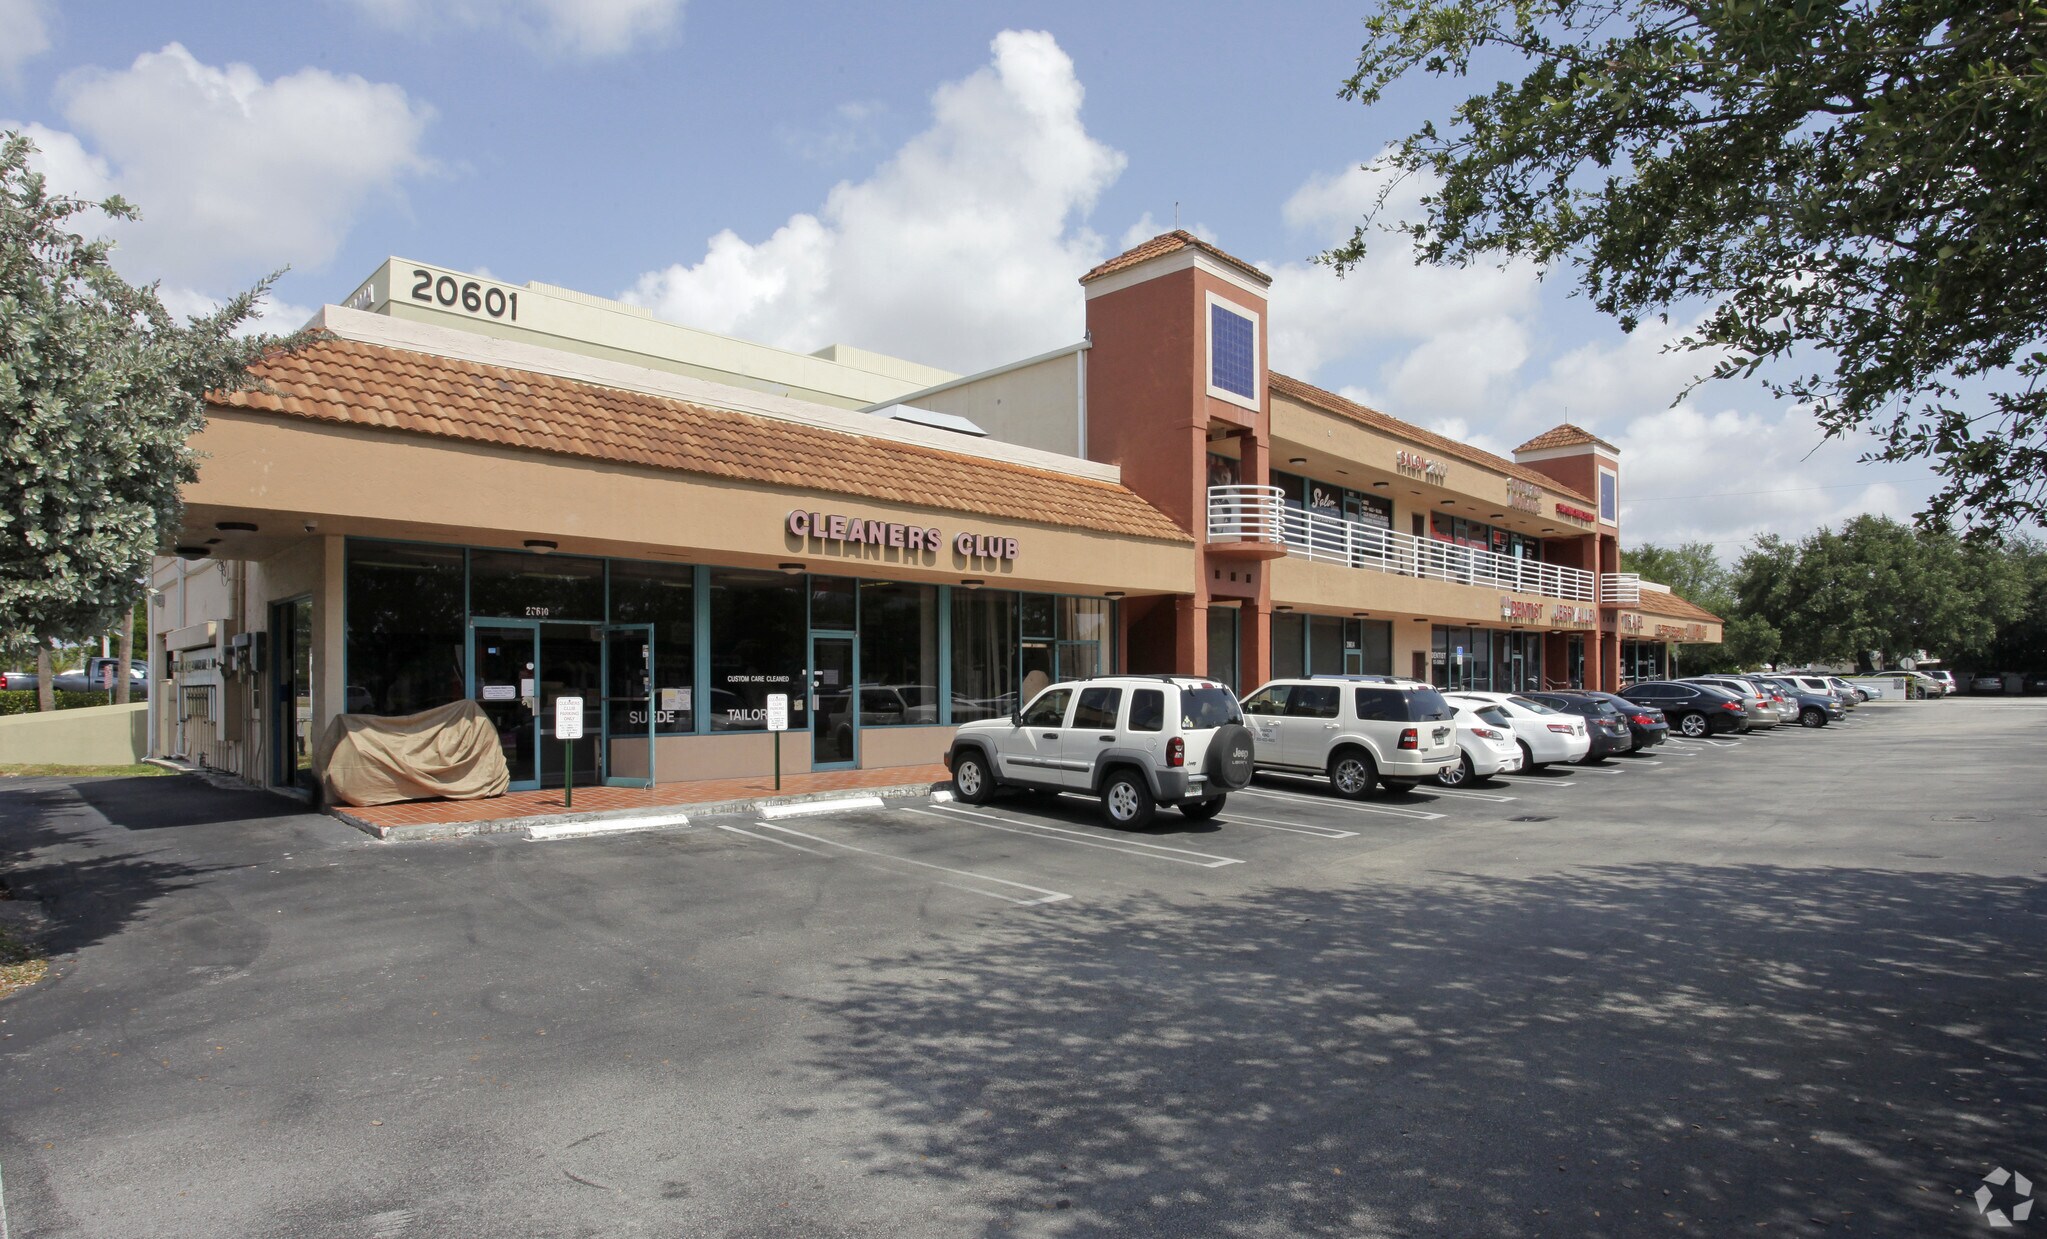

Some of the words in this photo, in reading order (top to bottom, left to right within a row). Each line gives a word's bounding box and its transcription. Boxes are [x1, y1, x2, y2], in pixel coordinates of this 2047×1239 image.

[412, 269, 518, 321] 20601
[1396, 449, 1426, 470] SALON
[785, 509, 943, 552] CLEANERS
[953, 532, 1020, 560] CLUB
[1511, 600, 1543, 619] DENTIST
[1552, 603, 1575, 623] JERRY
[629, 710, 675, 724] SUDE
[1232, 747, 1249, 759] Jeep
